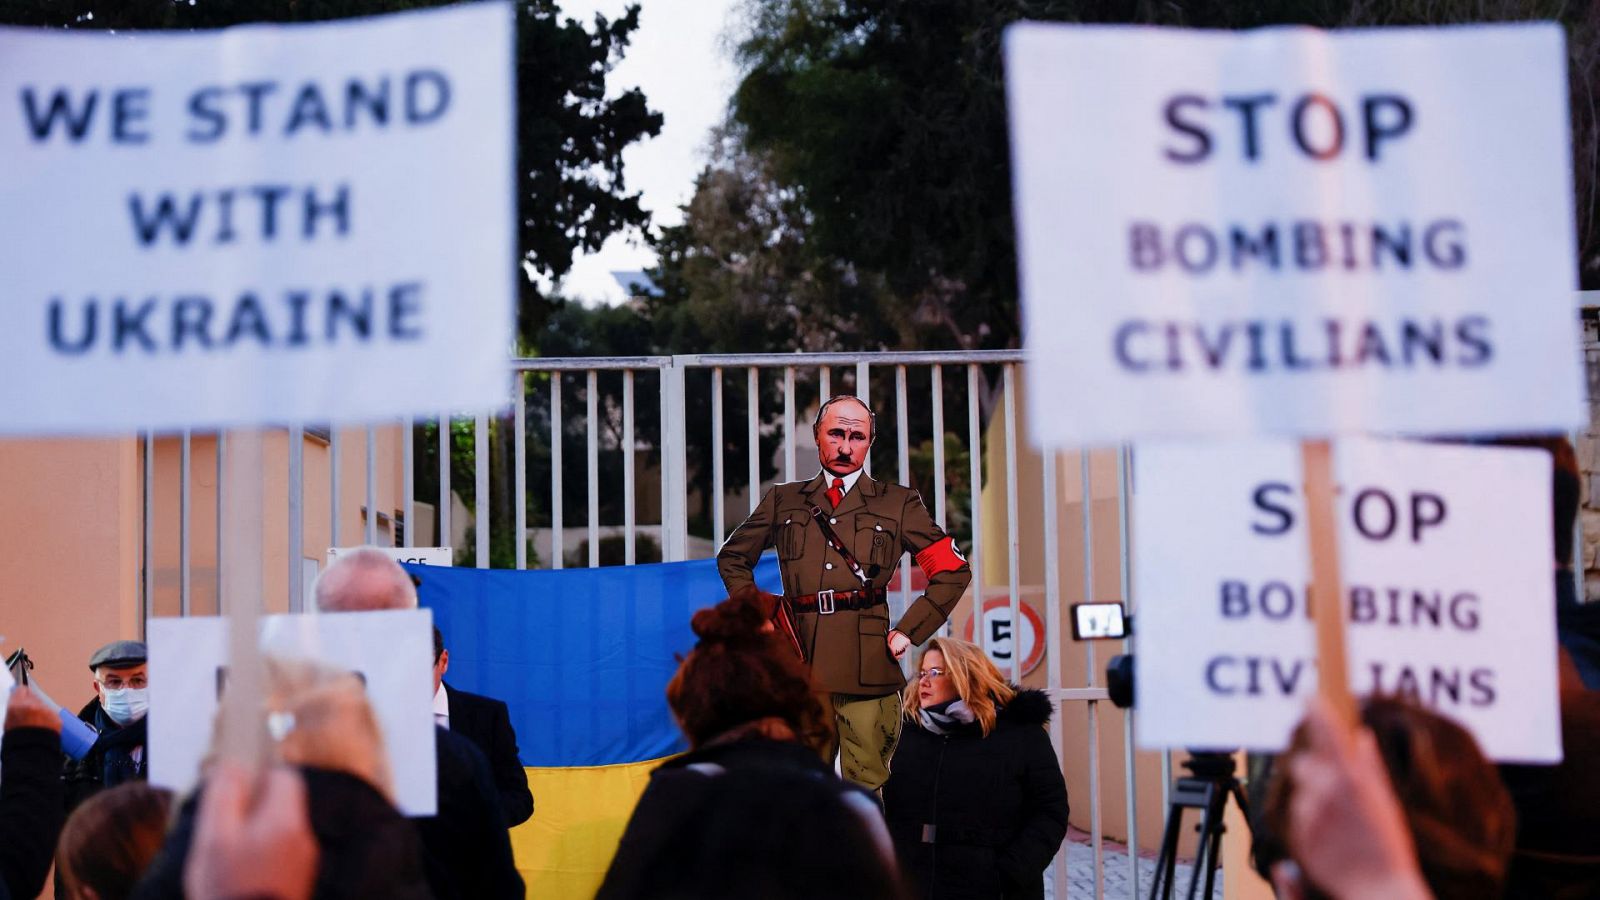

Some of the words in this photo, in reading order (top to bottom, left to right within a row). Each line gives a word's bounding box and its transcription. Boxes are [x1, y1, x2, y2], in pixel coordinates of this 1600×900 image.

[19, 86, 151, 146] WE
[185, 69, 453, 144] STAND
[1160, 91, 1417, 165] STOP
[127, 184, 351, 249] WITH
[1128, 219, 1467, 274] BOMBING
[45, 281, 424, 357] UKRAINE
[1112, 315, 1496, 374] CIVILIANS
[1250, 481, 1448, 544] SOP
[1218, 579, 1481, 632] BOBING
[991, 619, 1015, 660] 5
[1204, 655, 1497, 709] CIVIANS
